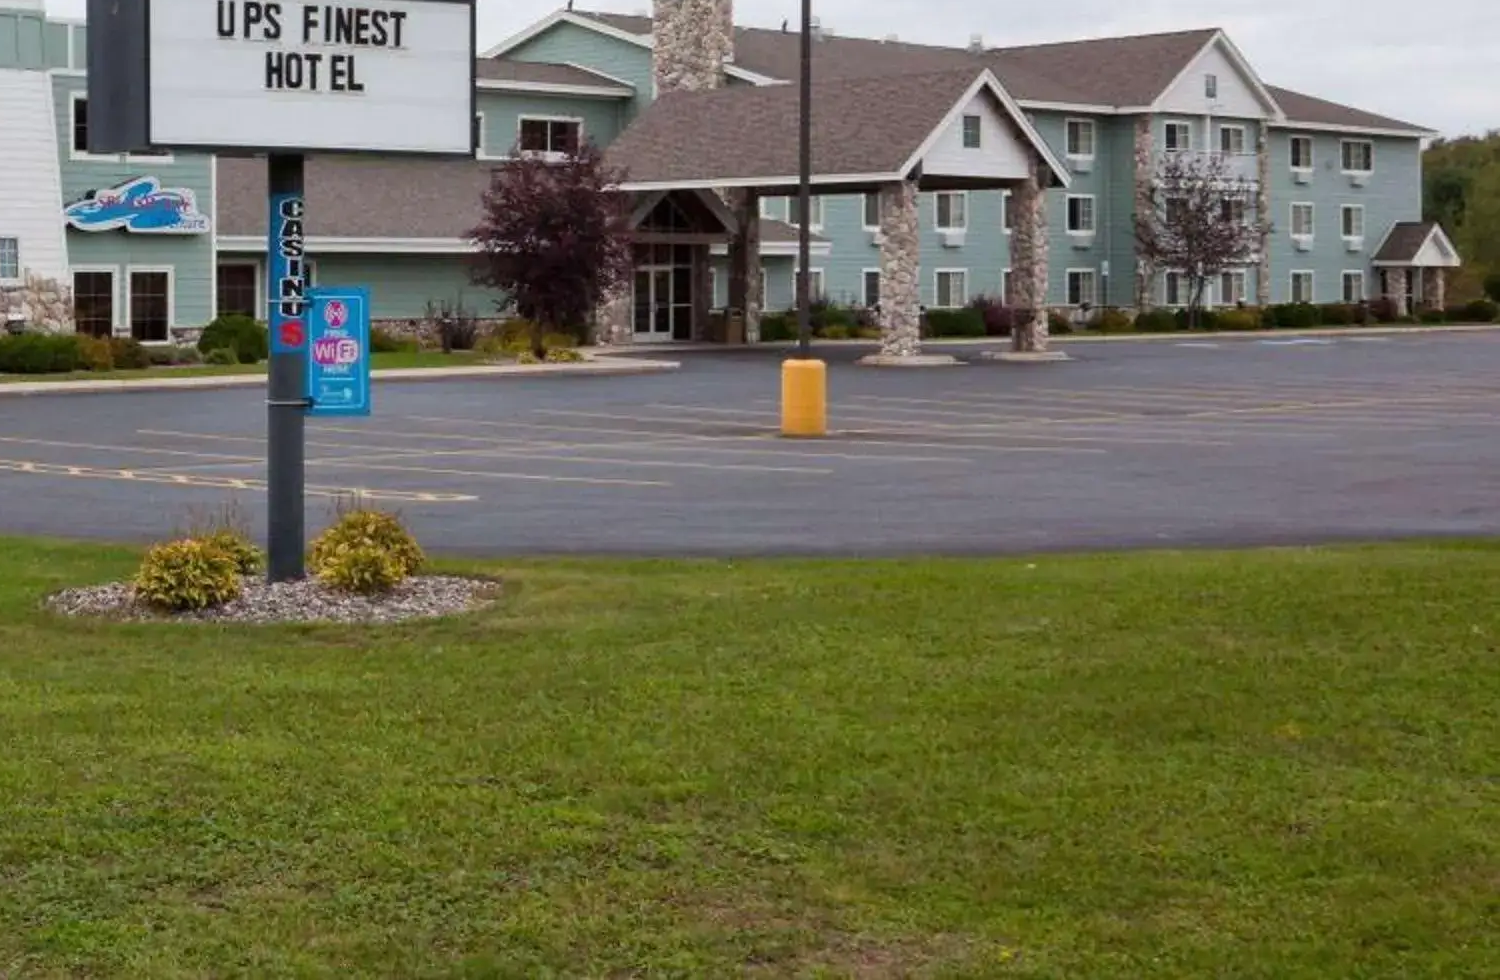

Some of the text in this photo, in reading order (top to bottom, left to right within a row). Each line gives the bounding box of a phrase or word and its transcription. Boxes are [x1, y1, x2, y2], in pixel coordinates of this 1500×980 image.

[216, 0, 407, 48] UPS FINEST
[265, 52, 365, 92] HOTEL
